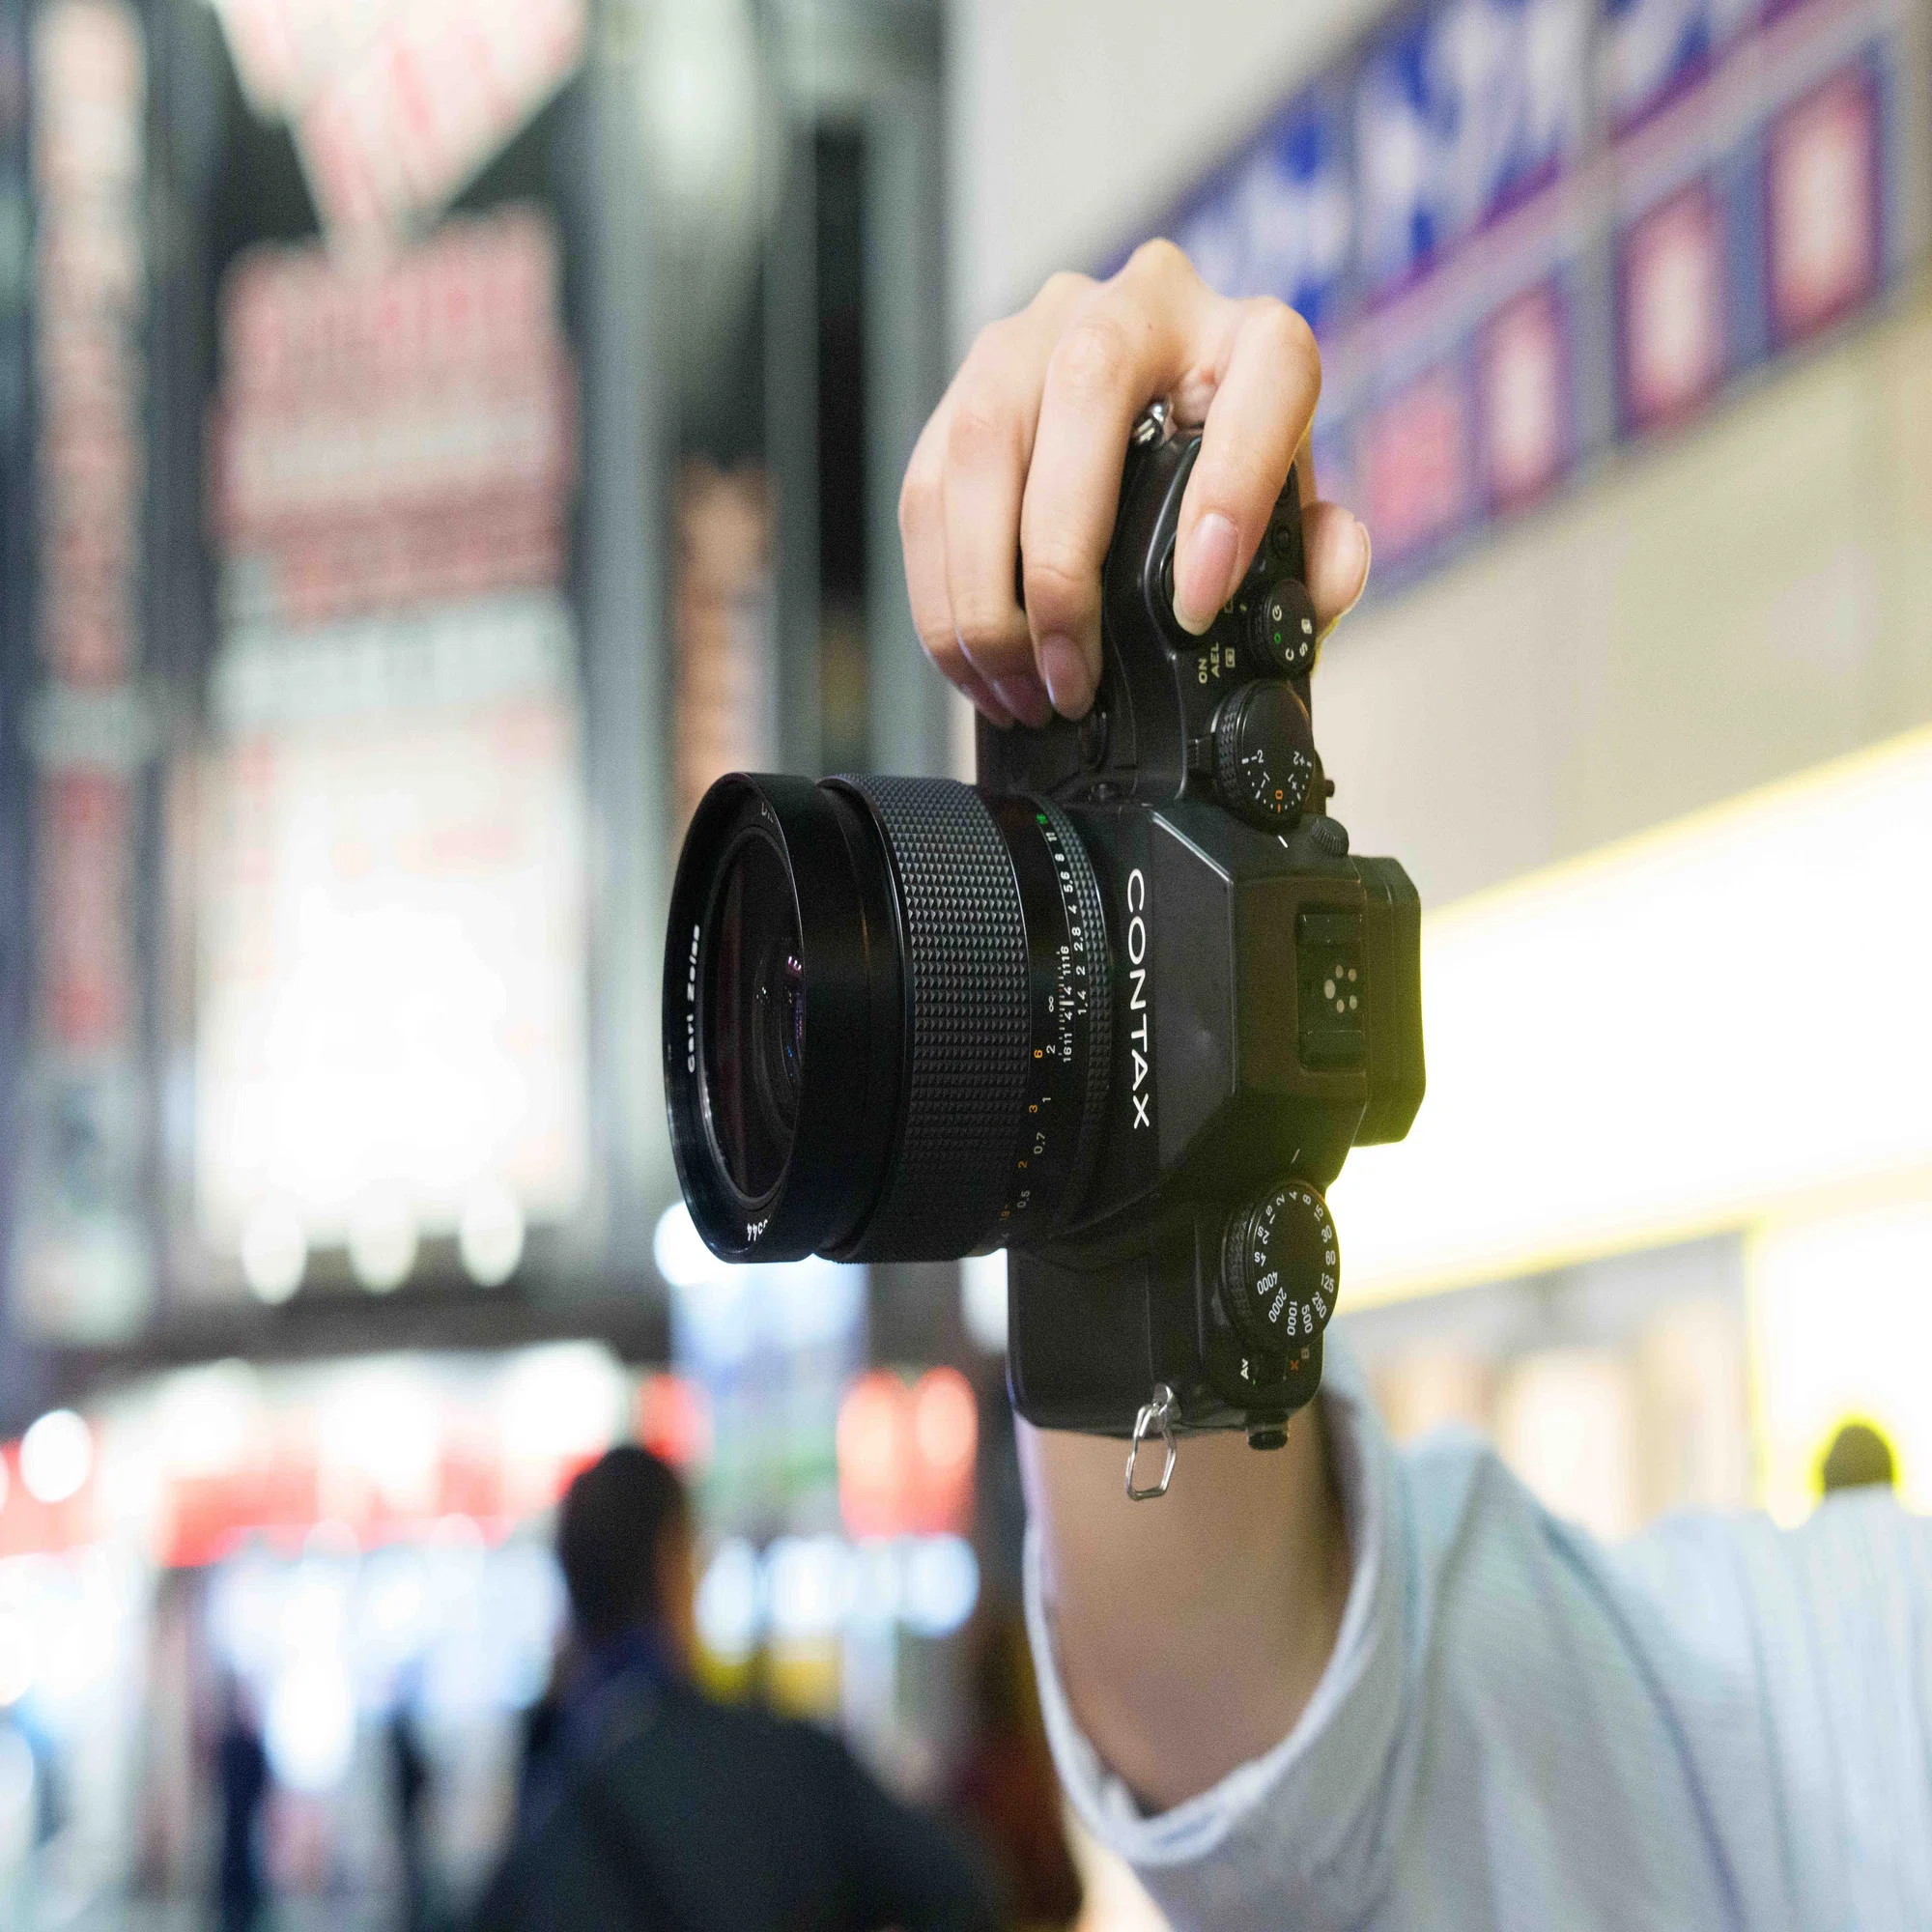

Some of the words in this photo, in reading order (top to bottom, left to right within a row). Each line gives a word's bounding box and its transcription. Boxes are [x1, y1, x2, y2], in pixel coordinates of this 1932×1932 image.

[1210, 641, 1220, 678] AEL
[1285, 647, 1294, 662] C
[1198, 658, 1208, 684] ON
[1055, 853, 1065, 863] 8
[1068, 904, 1077, 915] 4
[1075, 966, 1086, 976] 2
[1064, 985, 1072, 995] 4
[1127, 868, 1150, 1129] CONTAX
[1064, 1010, 1073, 1020] 4
[1034, 1049, 1043, 1059] 6
[1046, 1044, 1056, 1054] 2
[1029, 1104, 1037, 1113] 3
[1276, 1194, 1285, 1206] 2
[1302, 1194, 1312, 1206] 8
[1321, 1225, 1333, 1243] 30
[1325, 1250, 1336, 1265] 60
[1257, 1271, 1278, 1294] 4000
[1321, 1272, 1334, 1293] 125
[1268, 1287, 1287, 1323] 2000
[1312, 1292, 1327, 1319] 250
[1287, 1300, 1298, 1336] 1000
[1301, 1304, 1313, 1334] 500
